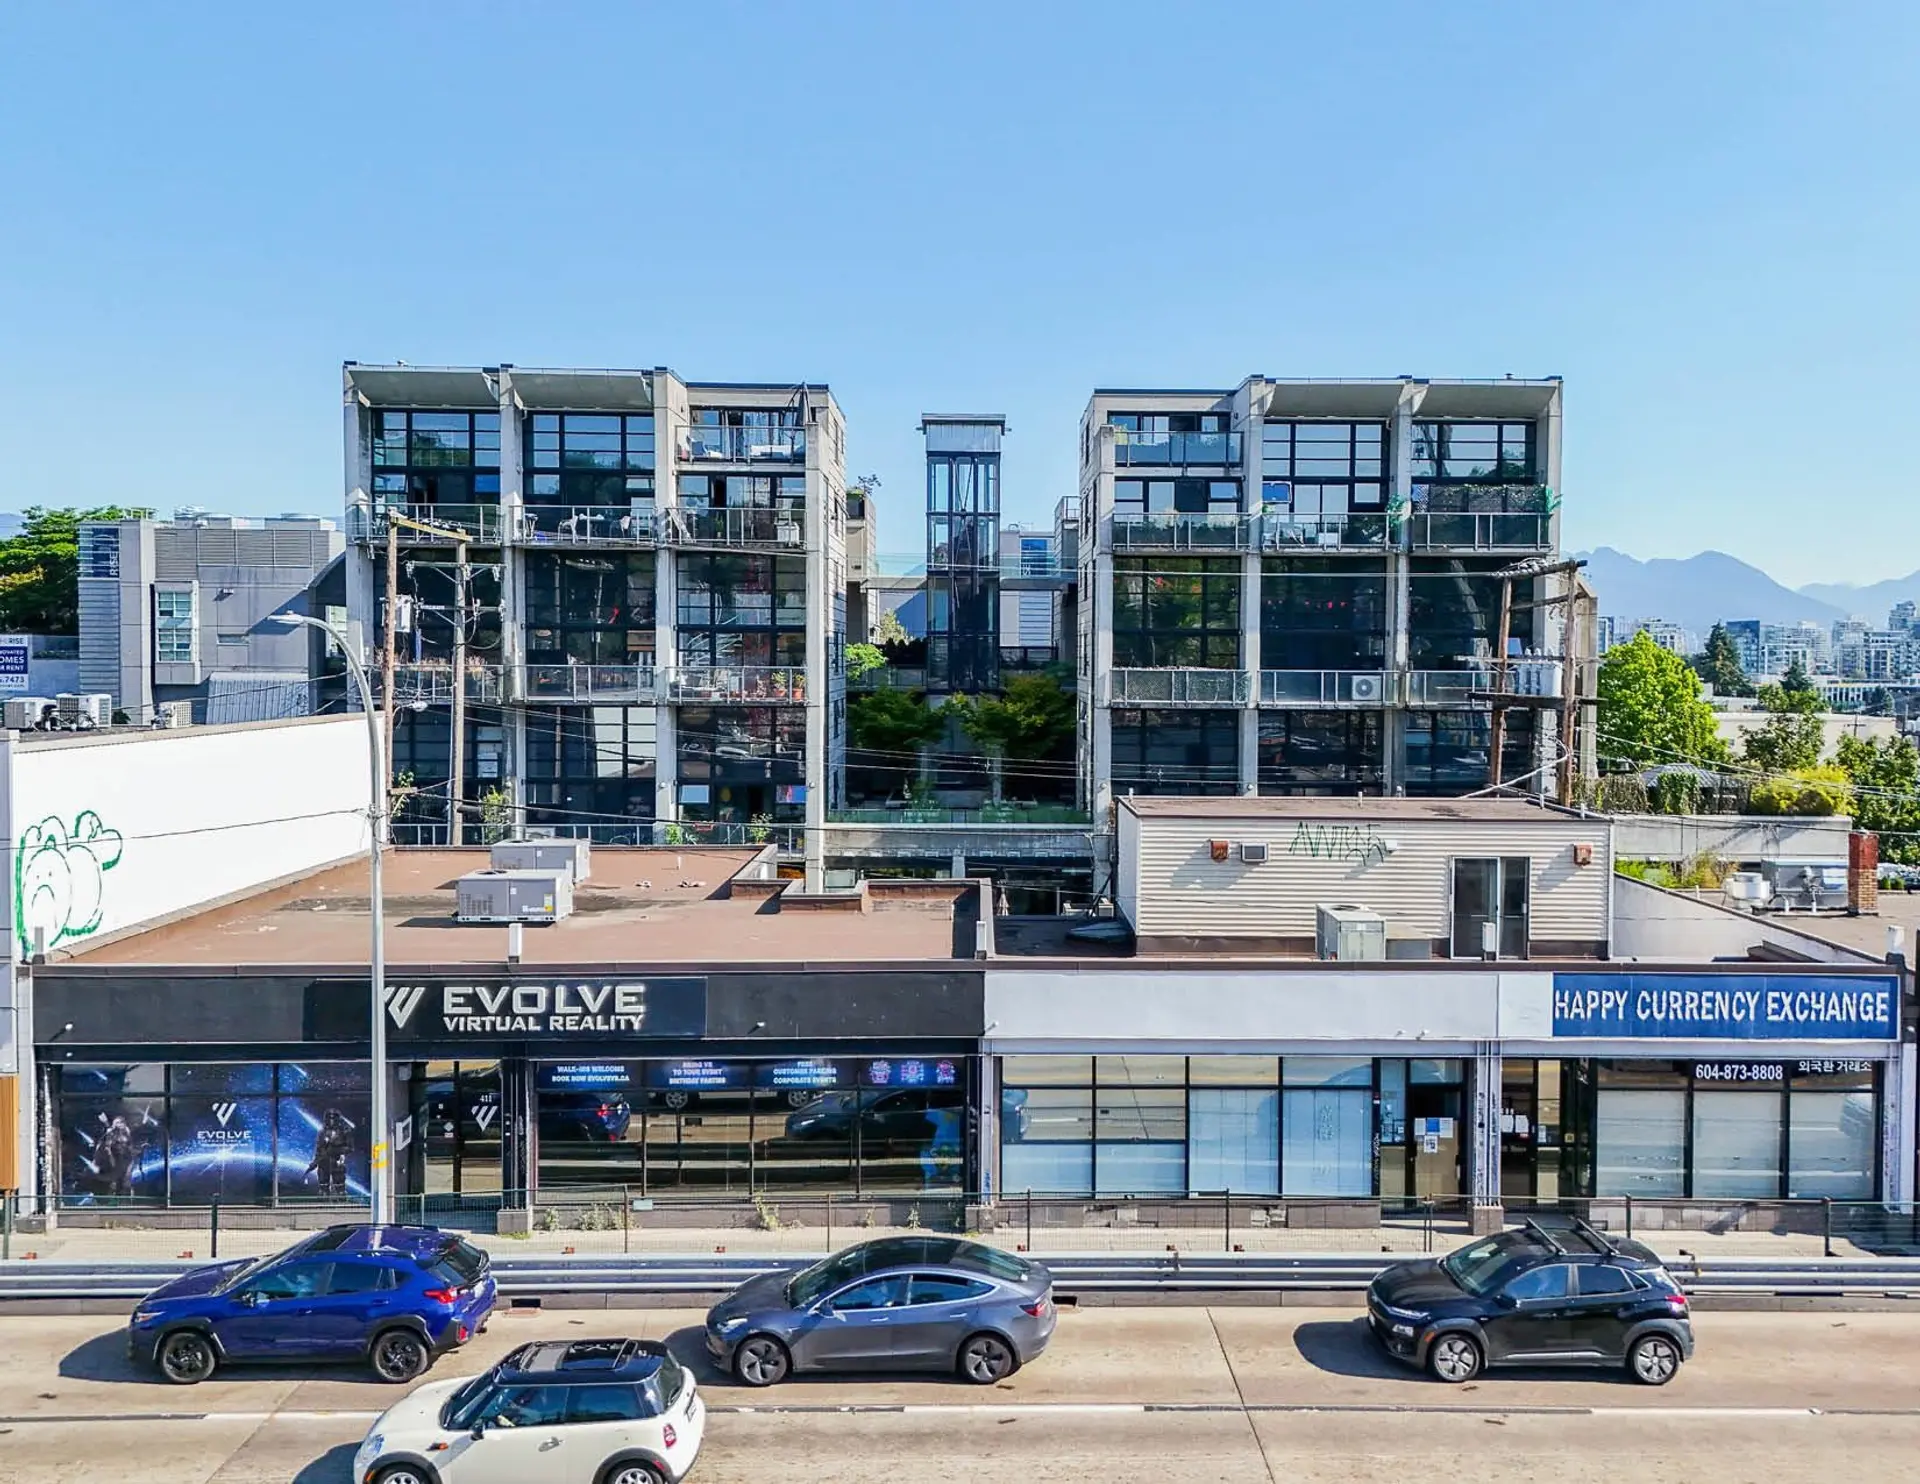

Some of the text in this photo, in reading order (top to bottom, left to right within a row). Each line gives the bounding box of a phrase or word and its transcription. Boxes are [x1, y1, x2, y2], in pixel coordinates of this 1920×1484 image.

[109, 552, 118, 576] RISE
[443, 985, 645, 1014] EVOLVE
[1554, 990, 1889, 1023] HAPPY CURRENCY EXCHANGE
[443, 1015, 645, 1032] VIRTUAL REALITY
[1695, 1064, 1783, 1081] 604-873-8808
[1798, 1060, 1872, 1073] 외국환 거래소
[479, 1094, 492, 1102] 411
[197, 1130, 252, 1140] EVOLVE
